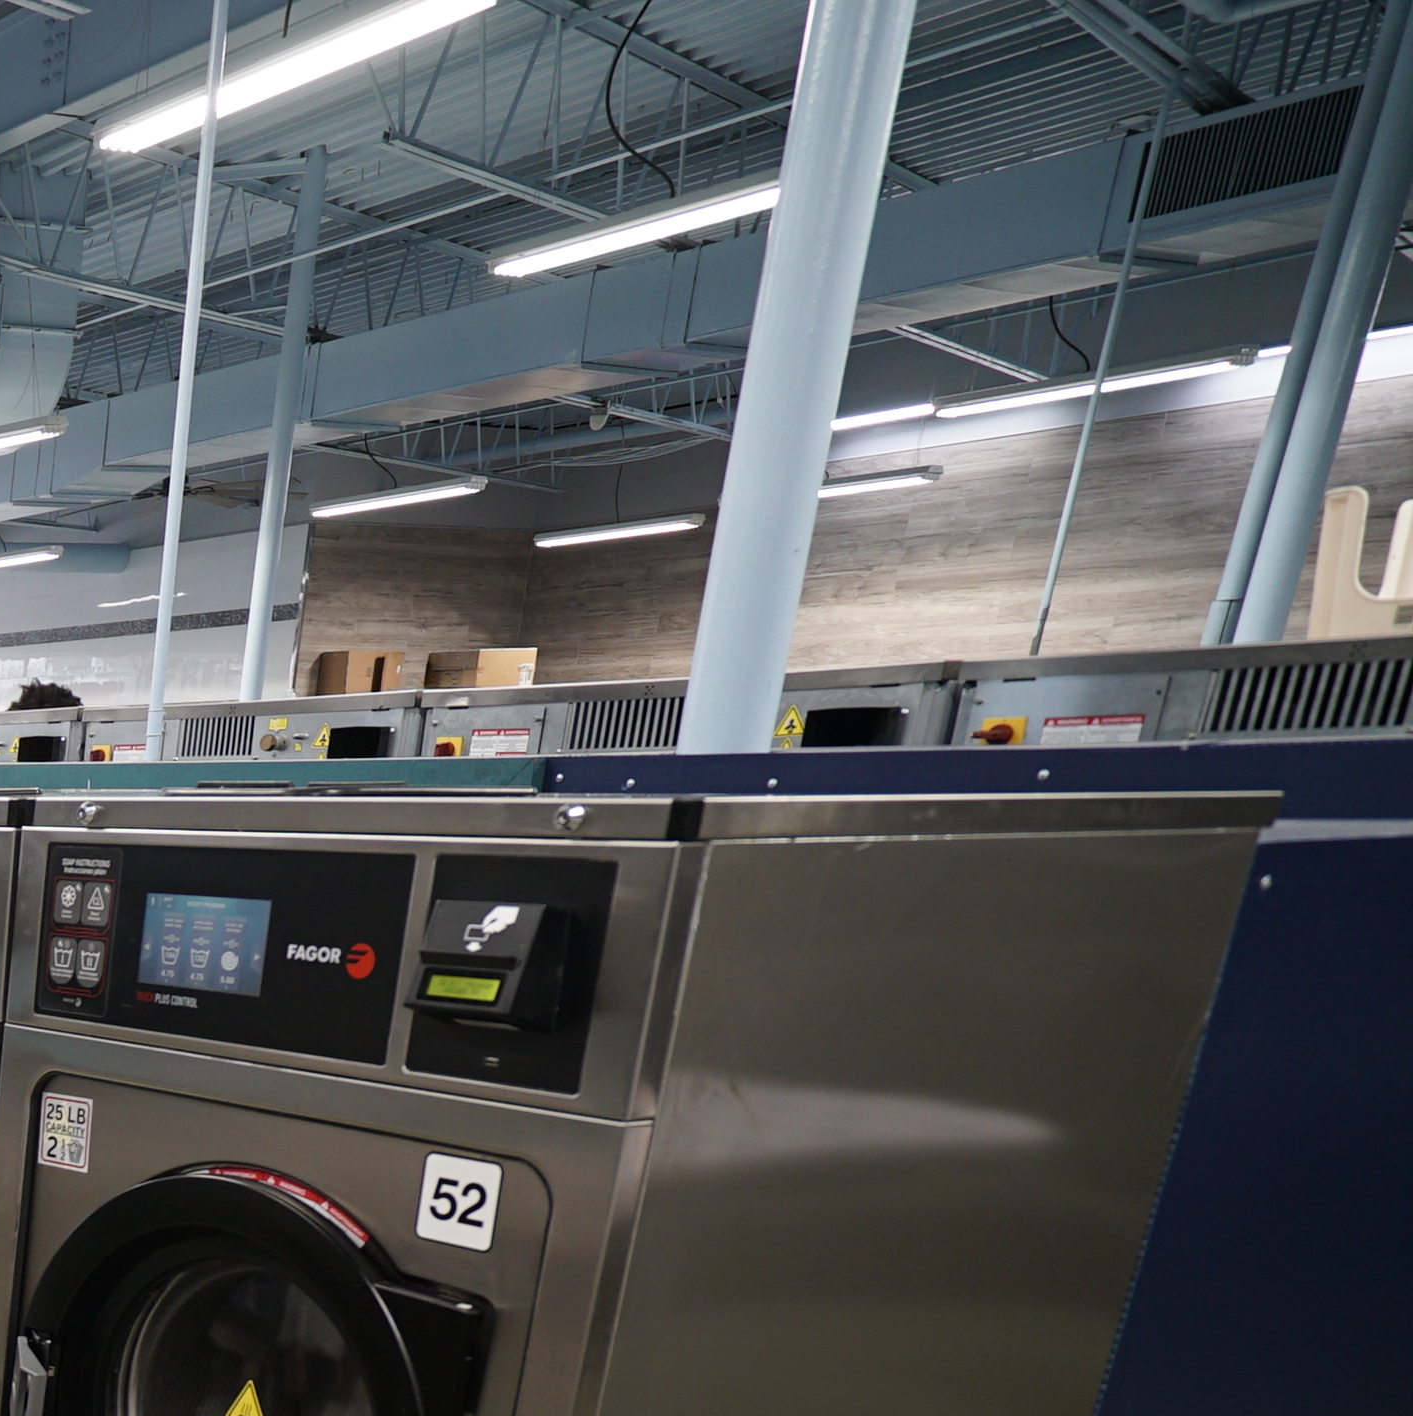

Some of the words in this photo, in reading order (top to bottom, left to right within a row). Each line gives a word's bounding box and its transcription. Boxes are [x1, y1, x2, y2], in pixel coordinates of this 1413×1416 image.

[286, 943, 341, 964] FAGOR
[46, 1103, 64, 1121] 25
[68, 1106, 86, 1125] LB
[45, 1121, 86, 1138] CAPACITY
[429, 1177, 487, 1228] 52
